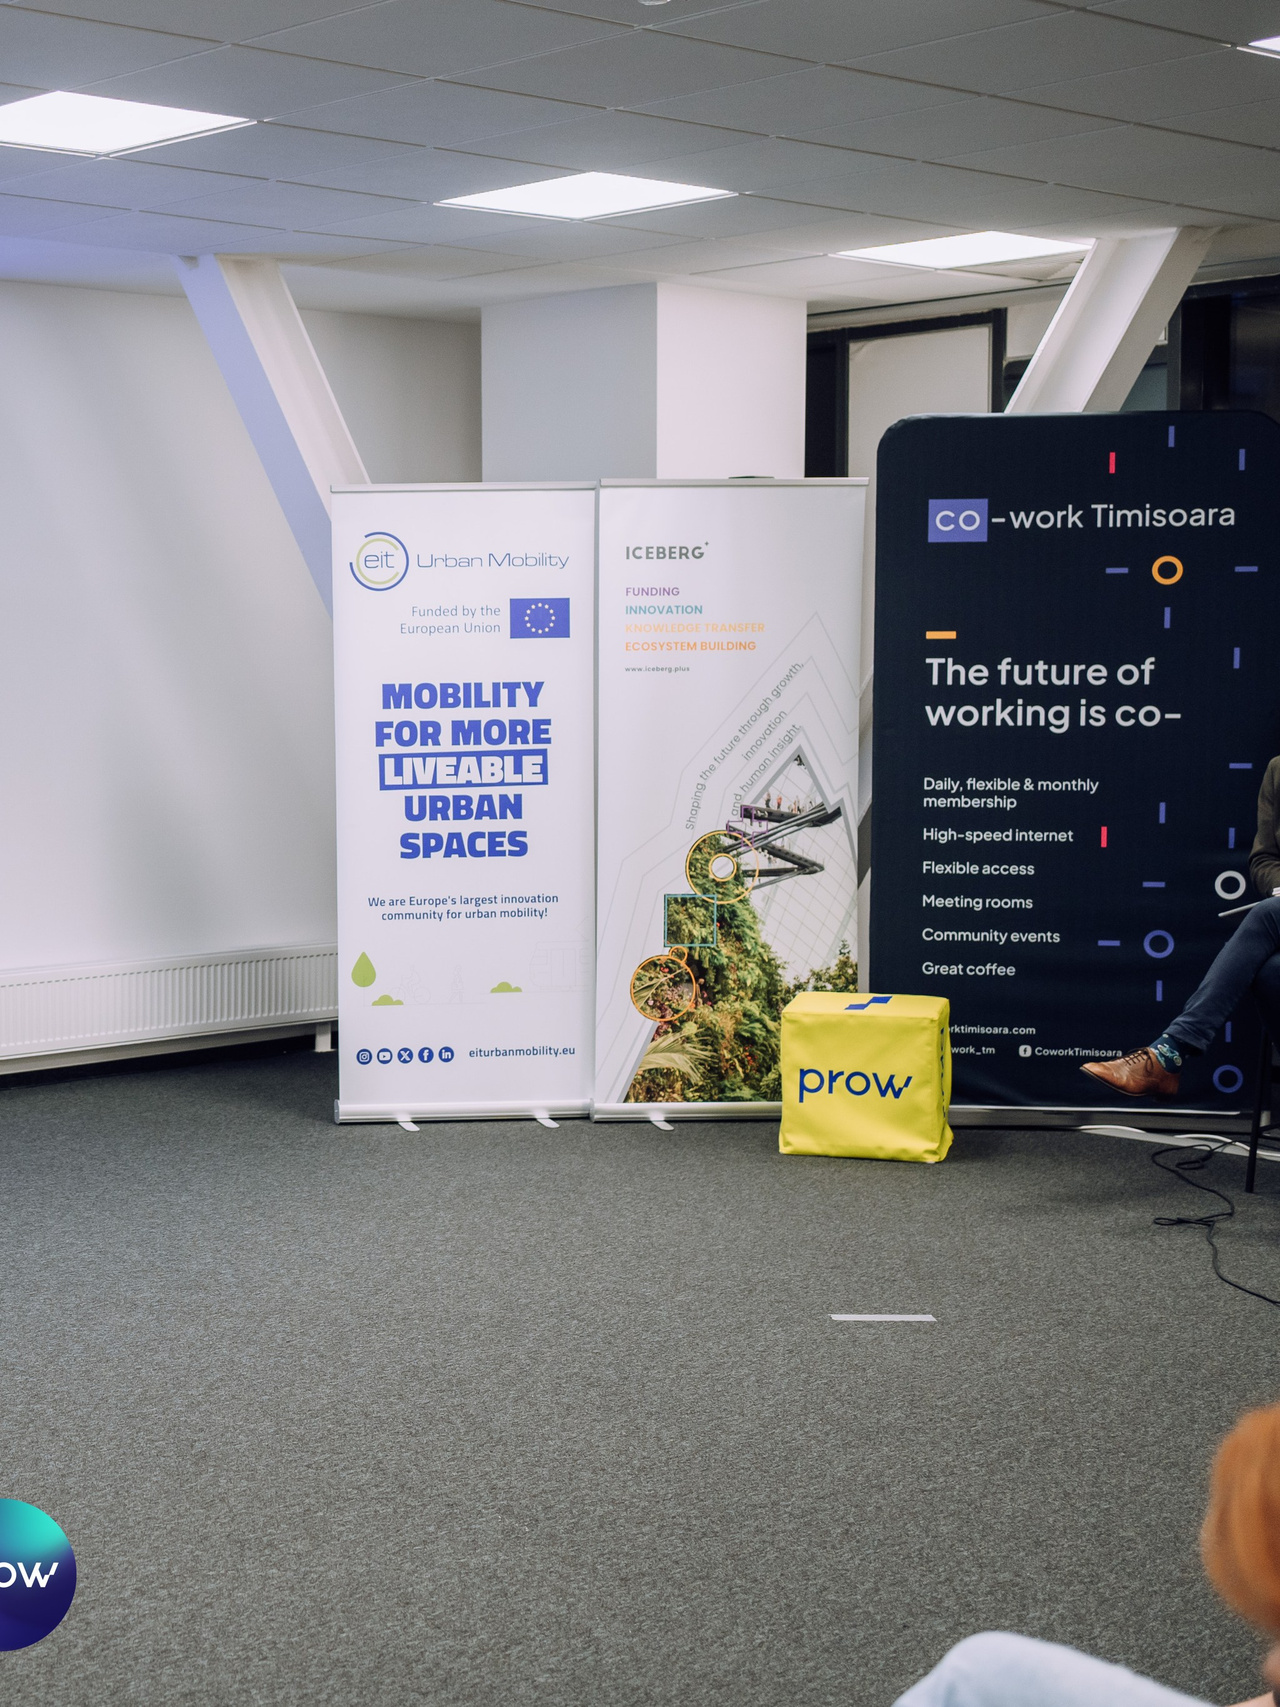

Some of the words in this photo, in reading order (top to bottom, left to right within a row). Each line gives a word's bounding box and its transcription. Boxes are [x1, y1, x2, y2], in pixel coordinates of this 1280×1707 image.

[1091, 503, 1236, 528] Timisoara
[364, 552, 395, 569] eit
[417, 554, 483, 568] Urban
[488, 553, 569, 569] Mobility
[625, 587, 680, 597] FUNDING
[412, 605, 459, 617] Funded
[462, 605, 476, 619] by
[480, 604, 501, 616] the
[625, 605, 703, 615] INNOVATION
[400, 623, 459, 637] European
[464, 622, 501, 633] Union
[625, 623, 701, 633] KNOWLEDGE
[704, 623, 765, 633] TRANSFER
[625, 642, 697, 651] ECOSYSTEM
[700, 641, 756, 651] BUILDING
[625, 666, 690, 674] www.iceberg.plus
[925, 657, 989, 686] The
[997, 657, 1107, 686] future
[1116, 657, 1155, 686] of
[382, 681, 545, 710] MOBILITY
[925, 698, 1070, 734] working
[1079, 699, 1106, 727] is
[1115, 704, 1182, 727] co-
[375, 720, 441, 747] FOR
[451, 718, 552, 746] MORE
[741, 710, 788, 761] innovation
[686, 782, 707, 830] Shaping
[699, 764, 716, 781] the
[713, 734, 741, 764] future
[738, 696, 773, 735] through
[771, 662, 805, 699] growth,
[383, 755, 543, 786] LIVEABLE
[731, 793, 743, 817] and
[739, 758, 771, 793] human
[768, 723, 802, 758] insight.
[923, 777, 963, 794] Daily,
[966, 777, 1020, 791] flexible
[1023, 778, 1034, 791] &
[1037, 778, 1099, 794] monthly
[404, 793, 522, 822] URBAN
[923, 795, 1017, 811] membership
[399, 830, 528, 859] SPACES
[923, 828, 1012, 844] High-speed
[1015, 829, 1074, 842] internet
[922, 860, 979, 875] Flexible
[981, 864, 1035, 875] access
[368, 897, 386, 907] We
[388, 898, 406, 907] are
[409, 895, 457, 908] Europe's
[460, 894, 498, 907] largest
[501, 894, 559, 904] innovation
[922, 894, 983, 911] Meeting
[985, 897, 1033, 909] rooms
[381, 909, 443, 922] community
[446, 909, 462, 919] for
[465, 908, 497, 919] urban
[500, 907, 548, 921] mobility!
[922, 928, 1008, 945] Community
[1010, 930, 1060, 943] events
[922, 962, 963, 976] Great
[966, 962, 1016, 976] coffee
[469, 1045, 575, 1058] eiturbanmobility.eu
[1035, 1047, 1122, 1057] CoworkTimisoara
[798, 1068, 913, 1104] prow
